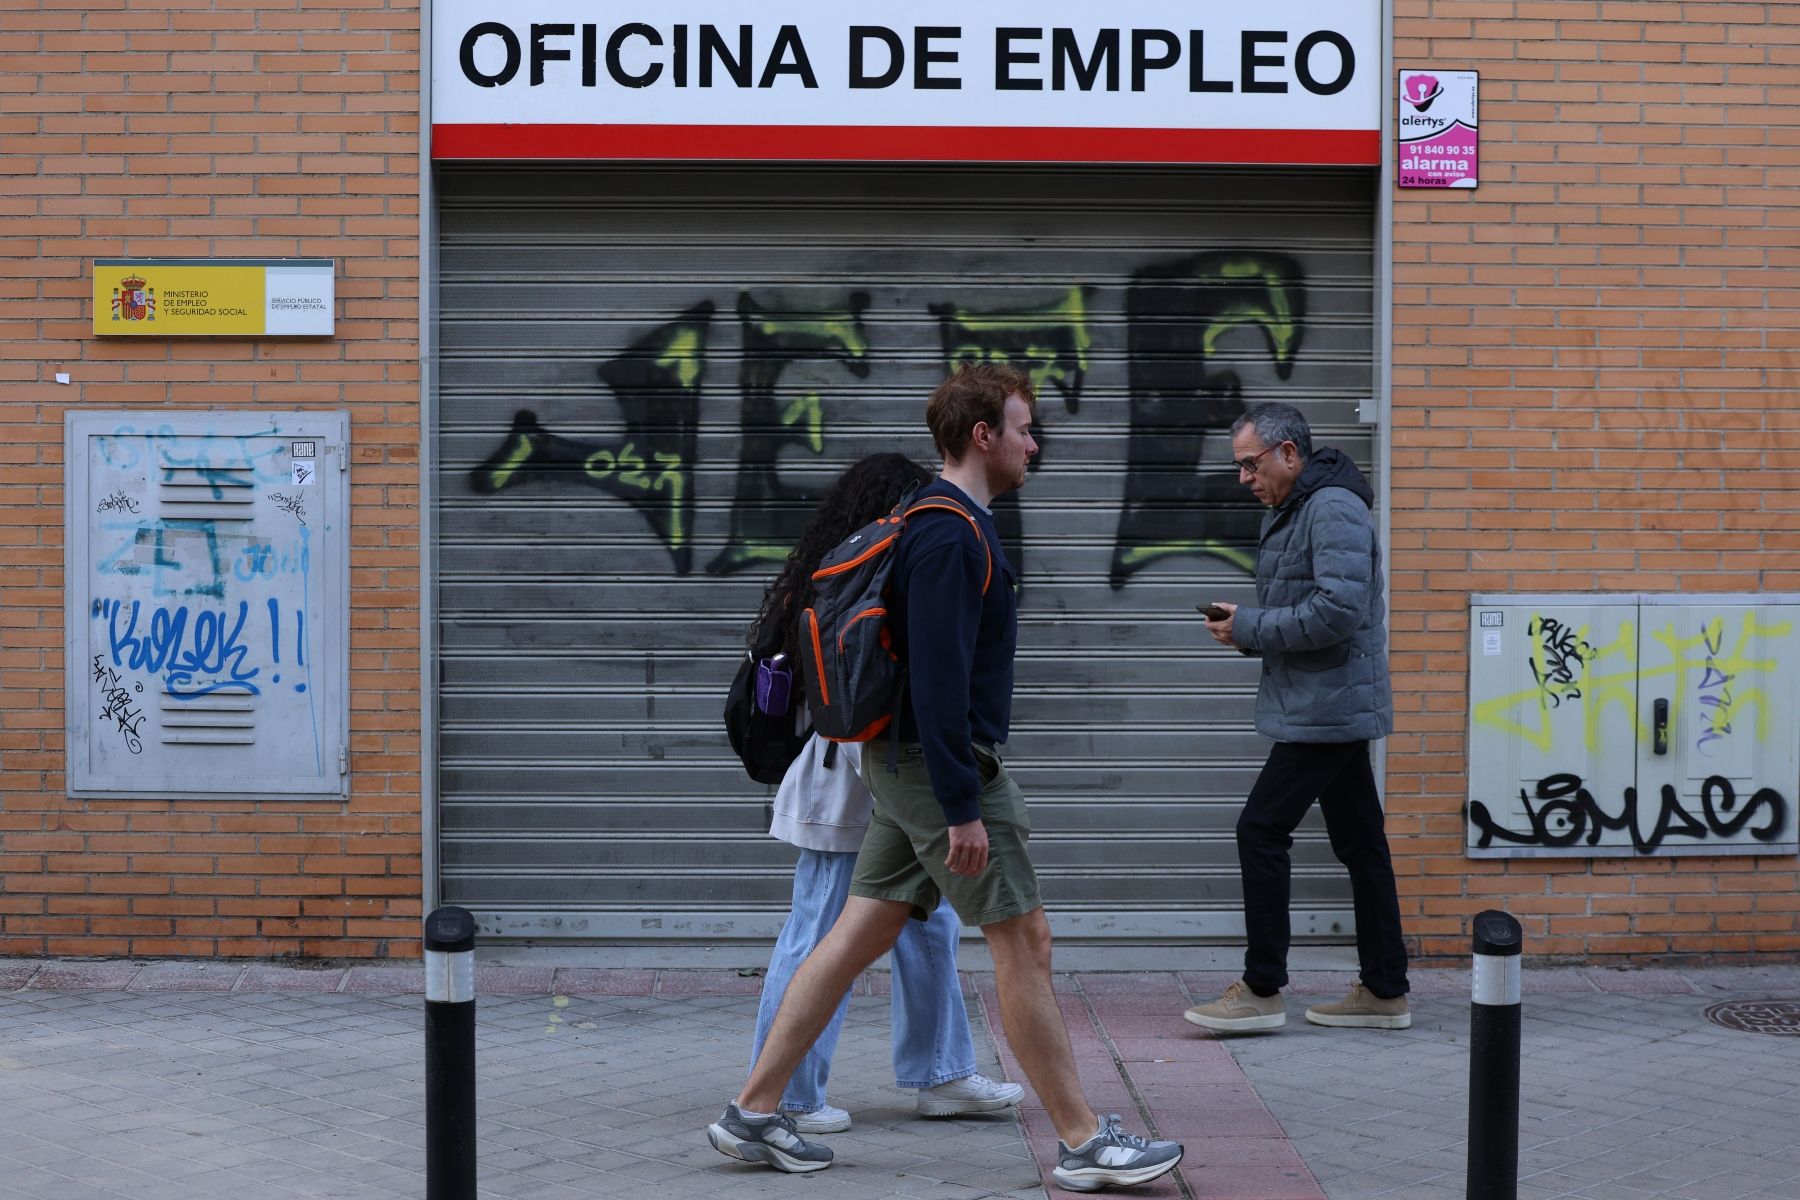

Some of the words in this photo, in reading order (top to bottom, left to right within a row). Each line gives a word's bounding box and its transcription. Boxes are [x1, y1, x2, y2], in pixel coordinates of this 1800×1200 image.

[460, 22, 819, 89] OFICINA
[849, 26, 962, 90] DE
[996, 28, 1356, 96] EMPLEO
[1402, 115, 1445, 128] alertys
[1410, 145, 1422, 154] 91
[1424, 146, 1444, 154] 840
[1446, 146, 1460, 155] 90
[1462, 146, 1475, 155] 35
[1402, 156, 1469, 170] alarma
[1402, 176, 1415, 185] 24
[1418, 176, 1447, 185] horas
[163, 290, 209, 298] MINISTERIO
[163, 299, 175, 307] DE
[176, 299, 207, 307] EMPLEO
[164, 308, 170, 316] Y
[171, 308, 217, 316] SEGURIDAD
[218, 308, 248, 316] SOCIAL
